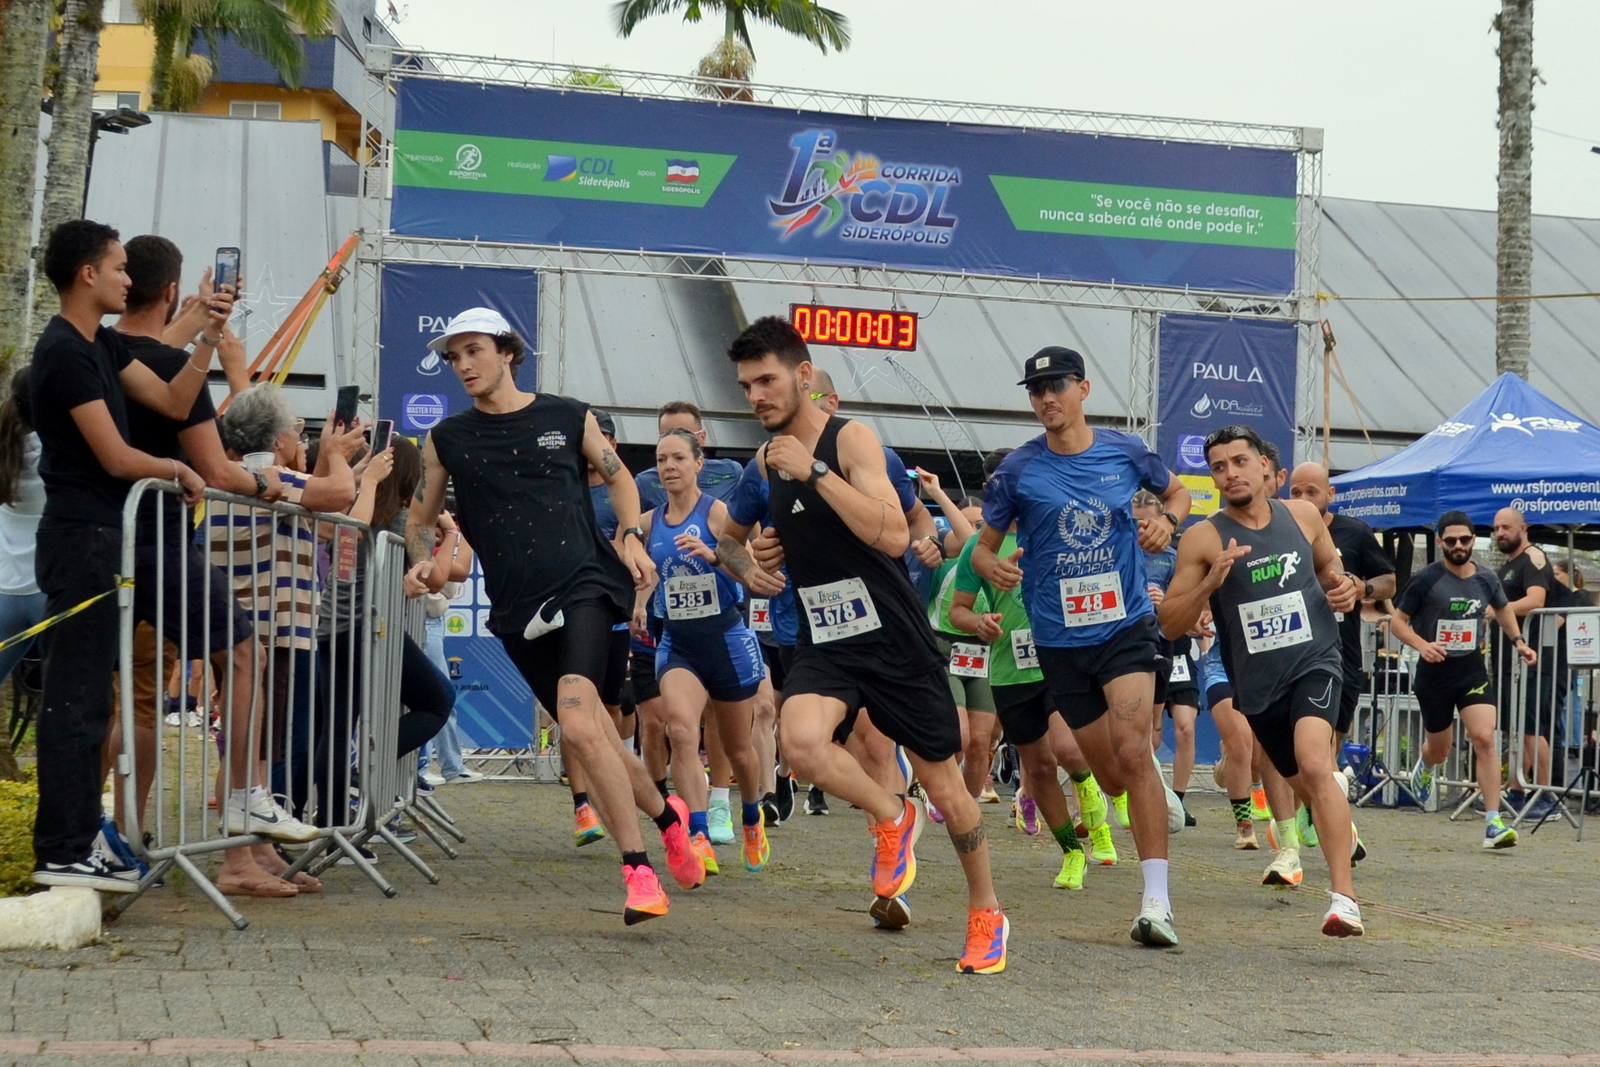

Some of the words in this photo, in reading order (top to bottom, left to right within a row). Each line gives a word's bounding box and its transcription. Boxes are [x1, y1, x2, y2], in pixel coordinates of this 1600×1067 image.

[403, 153, 444, 163] organização
[507, 160, 541, 170] realização
[579, 157, 616, 176] CDL
[449, 170, 487, 178] ESPORTIVA
[637, 169, 656, 177] apoio
[881, 165, 960, 183] CORRIDA
[578, 176, 631, 189] Siderópolis
[661, 184, 701, 195] SIDERÓPOLIS
[850, 180, 956, 228] CDL
[1091, 194, 1113, 208] "Se
[1117, 197, 1152, 211] você
[1156, 200, 1182, 213] não
[1187, 205, 1201, 214] se
[1205, 203, 1264, 220] desafiar,
[1039, 208, 1084, 222] nunca
[1088, 211, 1136, 226] saberá
[1140, 214, 1163, 228] até
[1167, 217, 1203, 231] onde
[1206, 221, 1242, 234] pode
[1246, 222, 1264, 234] ir."
[842, 226, 950, 244] SIDERÓPOLIS
[795, 307, 914, 347] 00:00:03
[1193, 362, 1263, 383] PAULA
[406, 406, 428, 414] MASTER
[1056, 545, 1115, 565] FAMILY
[1055, 559, 1116, 576] runners
[1251, 562, 1282, 583] RUN
[679, 591, 704, 608] 583
[1081, 594, 1103, 612] 48
[1450, 602, 1468, 611] RUN
[824, 602, 856, 626] 678
[1261, 613, 1292, 637] 597
[1449, 632, 1464, 642] 53
[740, 636, 760, 678] FAMILY
[965, 657, 974, 668] 5
